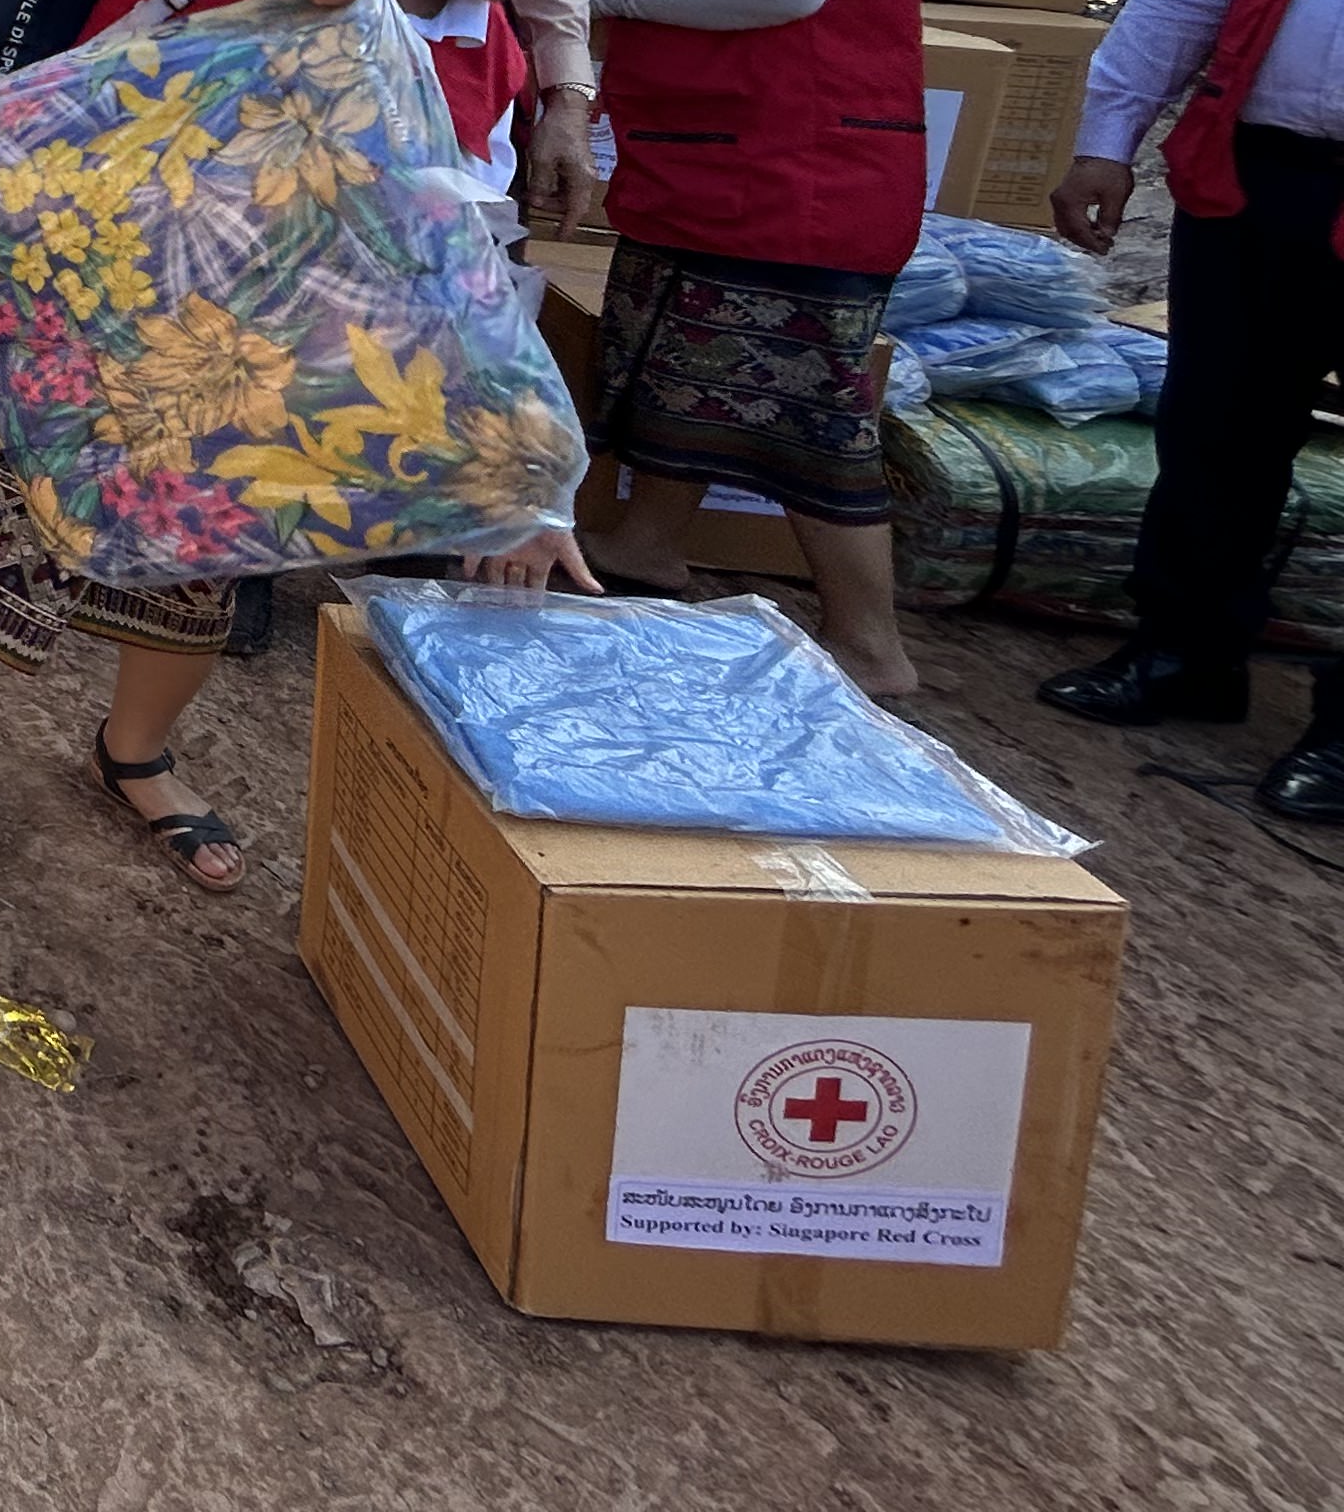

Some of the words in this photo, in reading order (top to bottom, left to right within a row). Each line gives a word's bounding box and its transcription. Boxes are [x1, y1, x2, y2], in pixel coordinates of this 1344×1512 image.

[10, 29, 24, 46] DI
[748, 1119, 867, 1170] CROIX-ROUGE
[866, 1124, 899, 1155] LAO
[619, 1214, 725, 1235] Supported
[730, 1220, 762, 1238] by:
[768, 1223, 871, 1244] Singapore
[877, 1228, 916, 1244] Red
[922, 1230, 983, 1248] Cross
